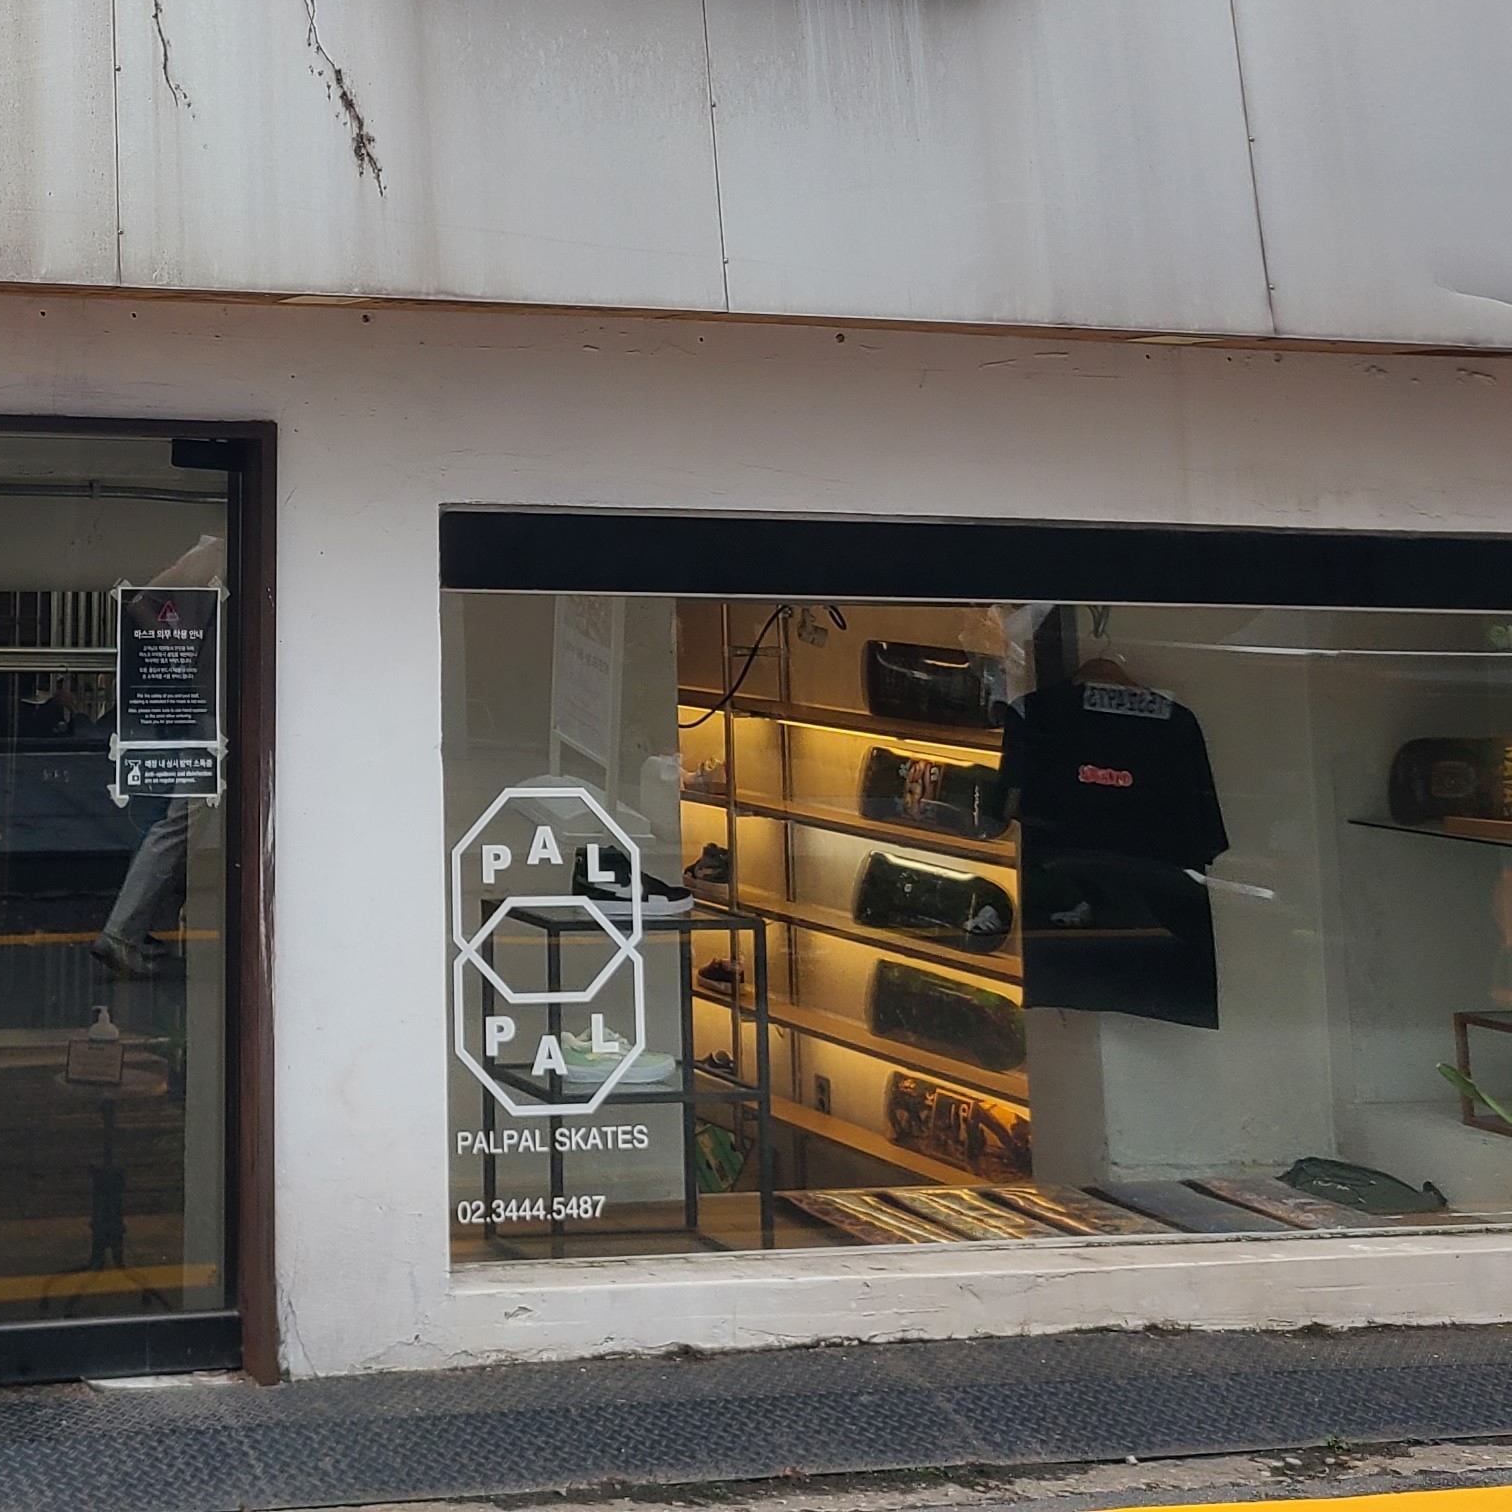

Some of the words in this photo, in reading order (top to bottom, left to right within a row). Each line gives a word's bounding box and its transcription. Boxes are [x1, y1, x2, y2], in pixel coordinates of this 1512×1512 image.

[134, 629, 155, 639] 마스크
[157, 629, 171, 639] 의무
[189, 629, 203, 639] 안내
[481, 825, 616, 884] PAL
[485, 1013, 620, 1076] PAL
[457, 1128, 548, 1155] PALPAL
[554, 1125, 650, 1151] SKATES
[457, 1195, 606, 1224] 02.3444.5487
